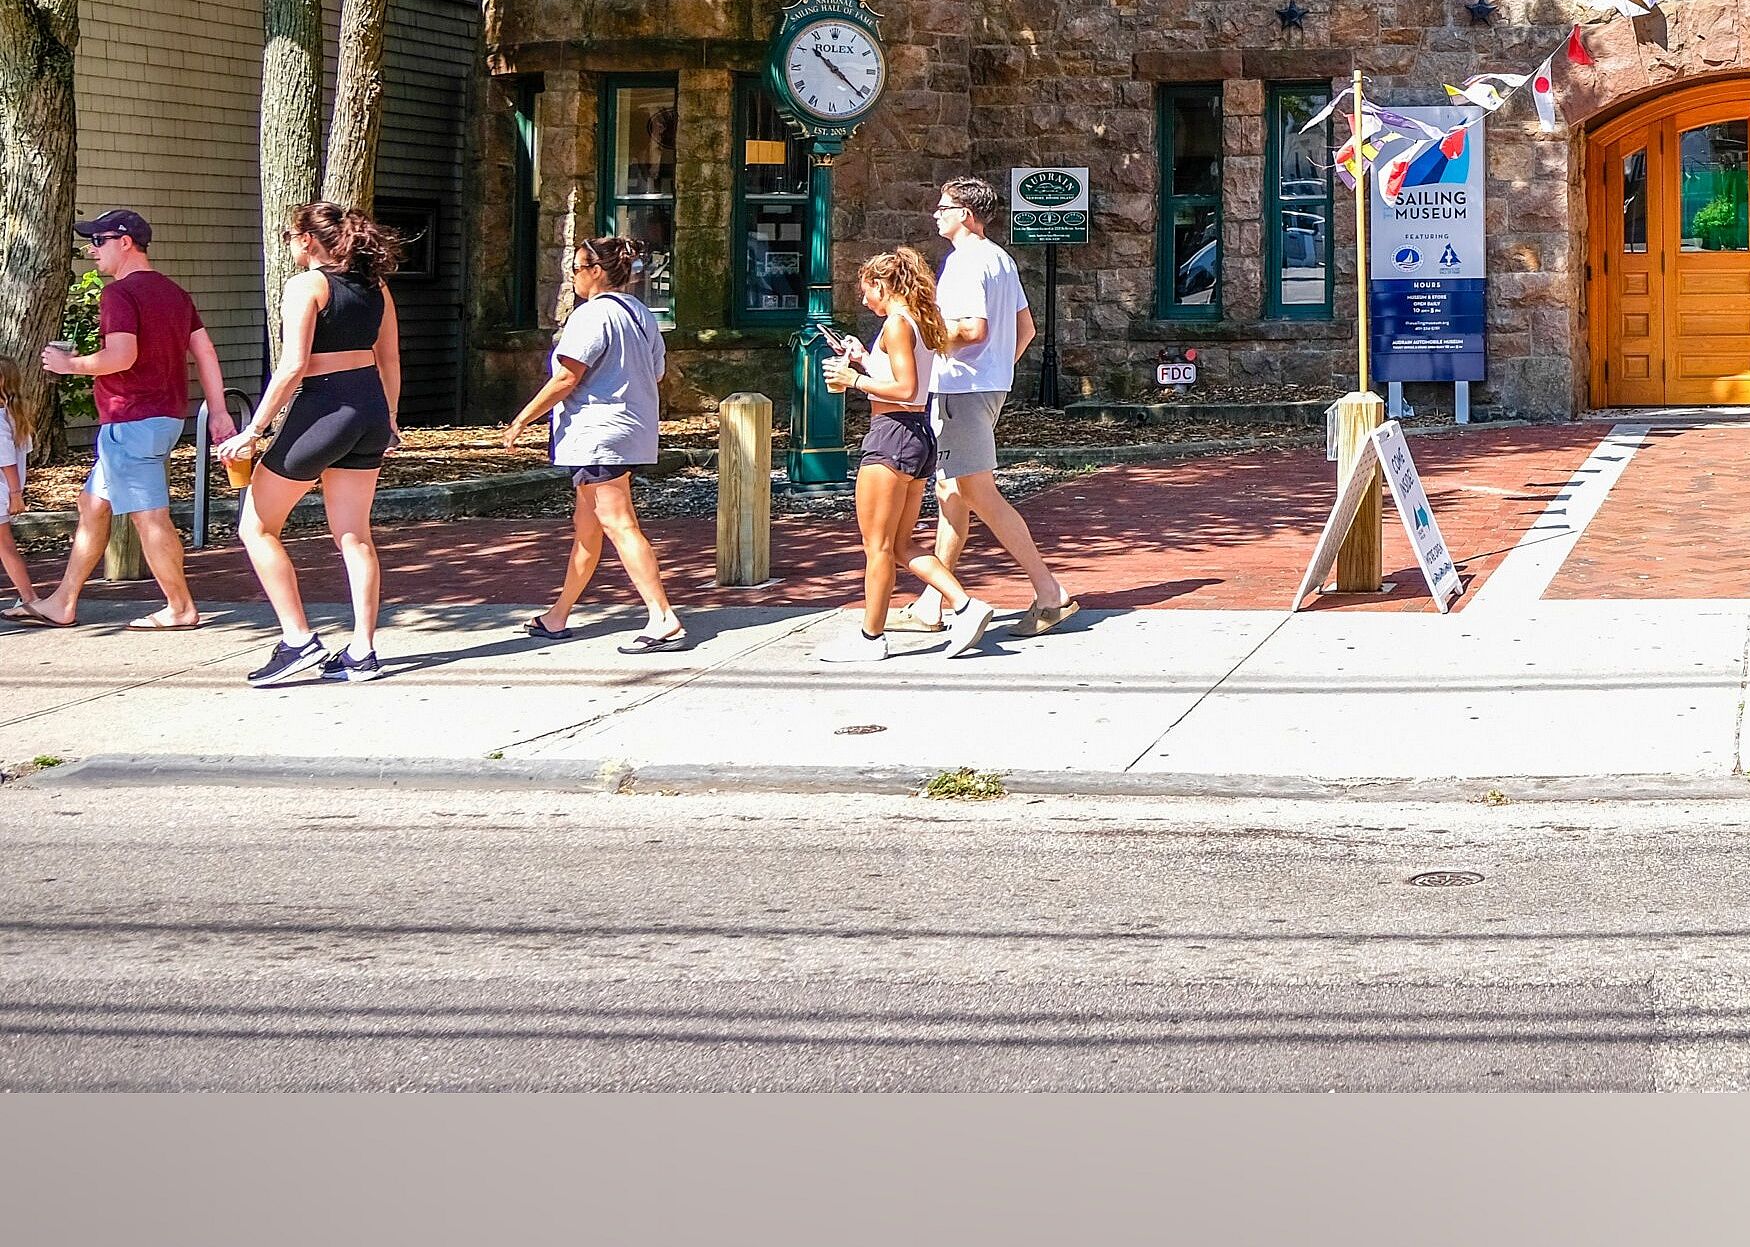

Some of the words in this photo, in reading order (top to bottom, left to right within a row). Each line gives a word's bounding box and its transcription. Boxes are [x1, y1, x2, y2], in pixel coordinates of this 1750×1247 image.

[790, 6, 818, 22] SAILING
[854, 12, 874, 28] FAME
[814, 44, 854, 54] ROLEX
[814, 127, 829, 136] EST.
[1025, 172, 1074, 192] AUDRAIN
[1395, 192, 1466, 205] SAILING
[1396, 208, 1466, 219] MUSEUM
[1162, 367, 1192, 380] FDC
